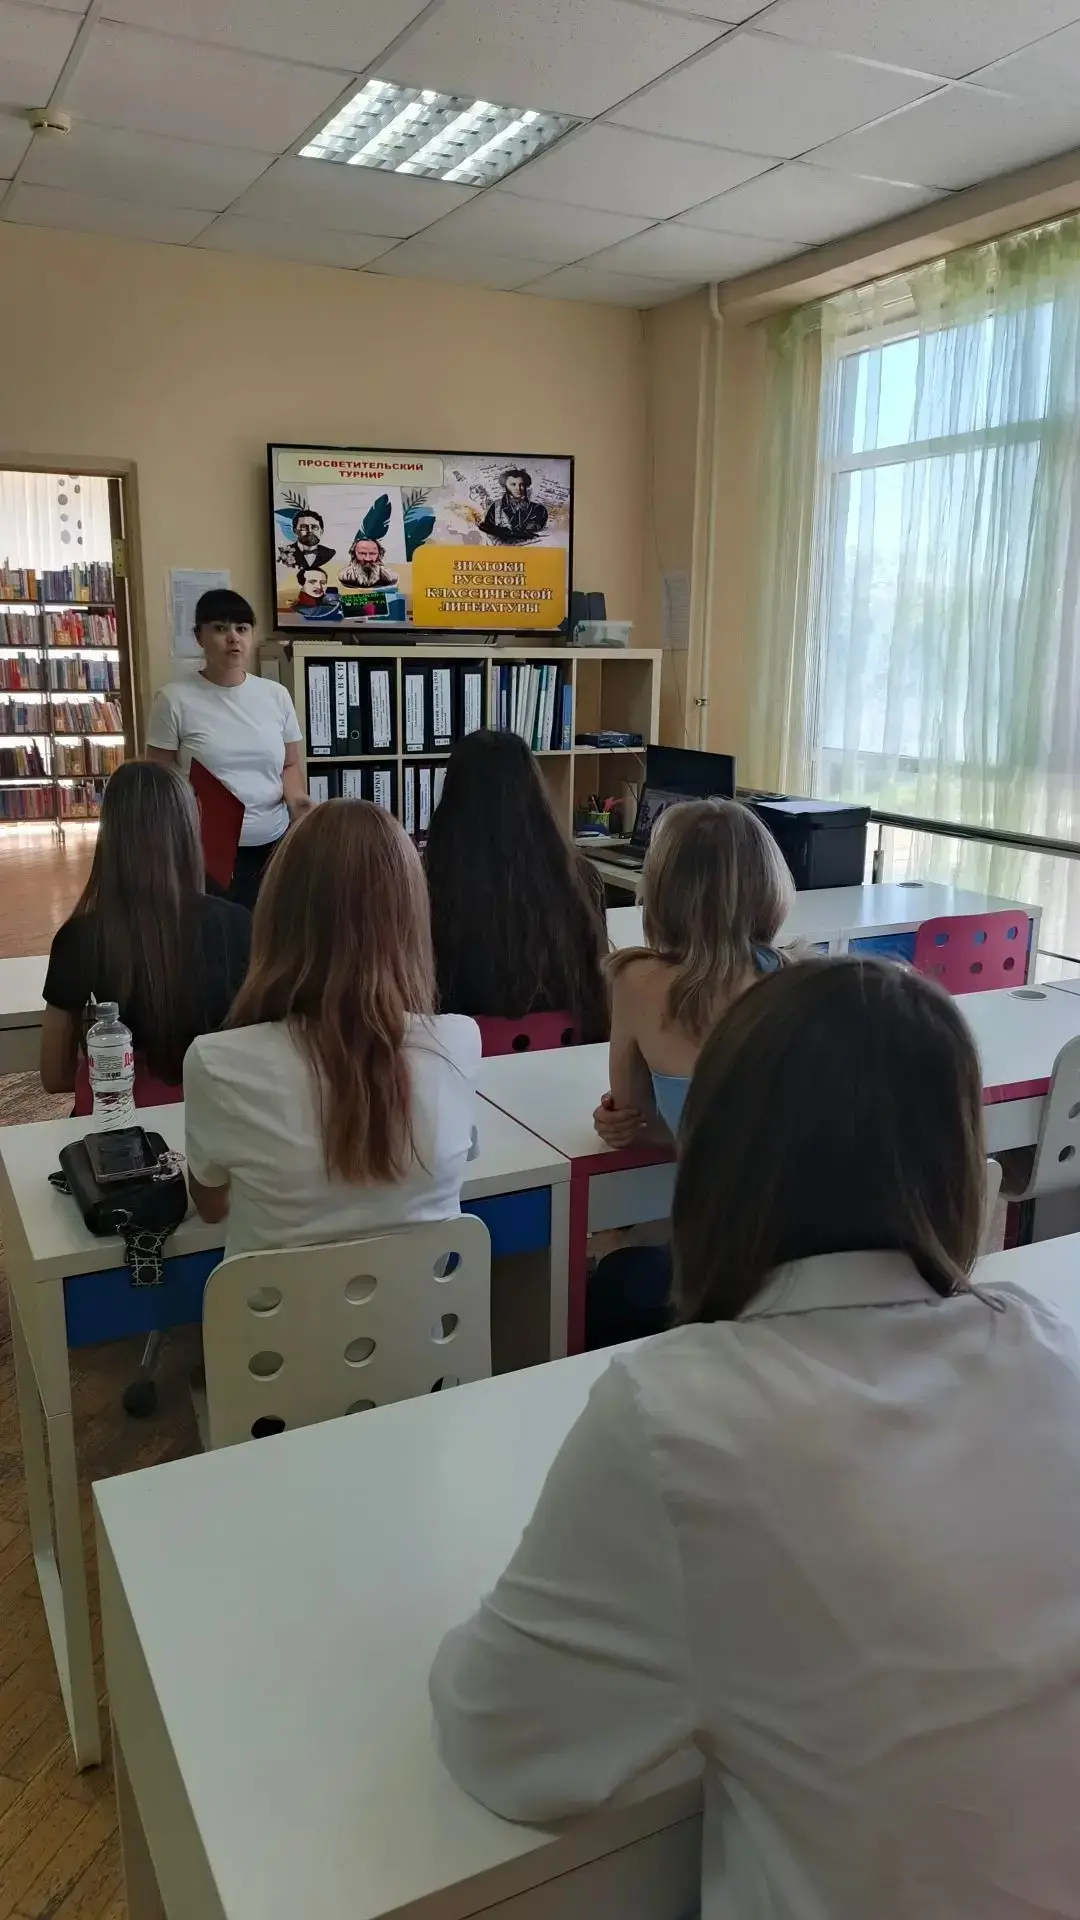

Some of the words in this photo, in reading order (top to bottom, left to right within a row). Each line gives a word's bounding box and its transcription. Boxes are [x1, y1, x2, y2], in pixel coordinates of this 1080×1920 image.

[298, 459, 424, 471] ПРОСВЕТИТЕЛЬСКИЙ
[338, 470, 385, 479] ТУРНИР
[453, 560, 526, 572] ЗНАТОКИ
[452, 573, 527, 585] РУССКОЙ
[425, 586, 553, 600] КЛАССИЧЕСКОЙ
[439, 600, 540, 613] ЛИТЕРАТУРЫ
[335, 663, 346, 737] ВЫСТАВКИ
